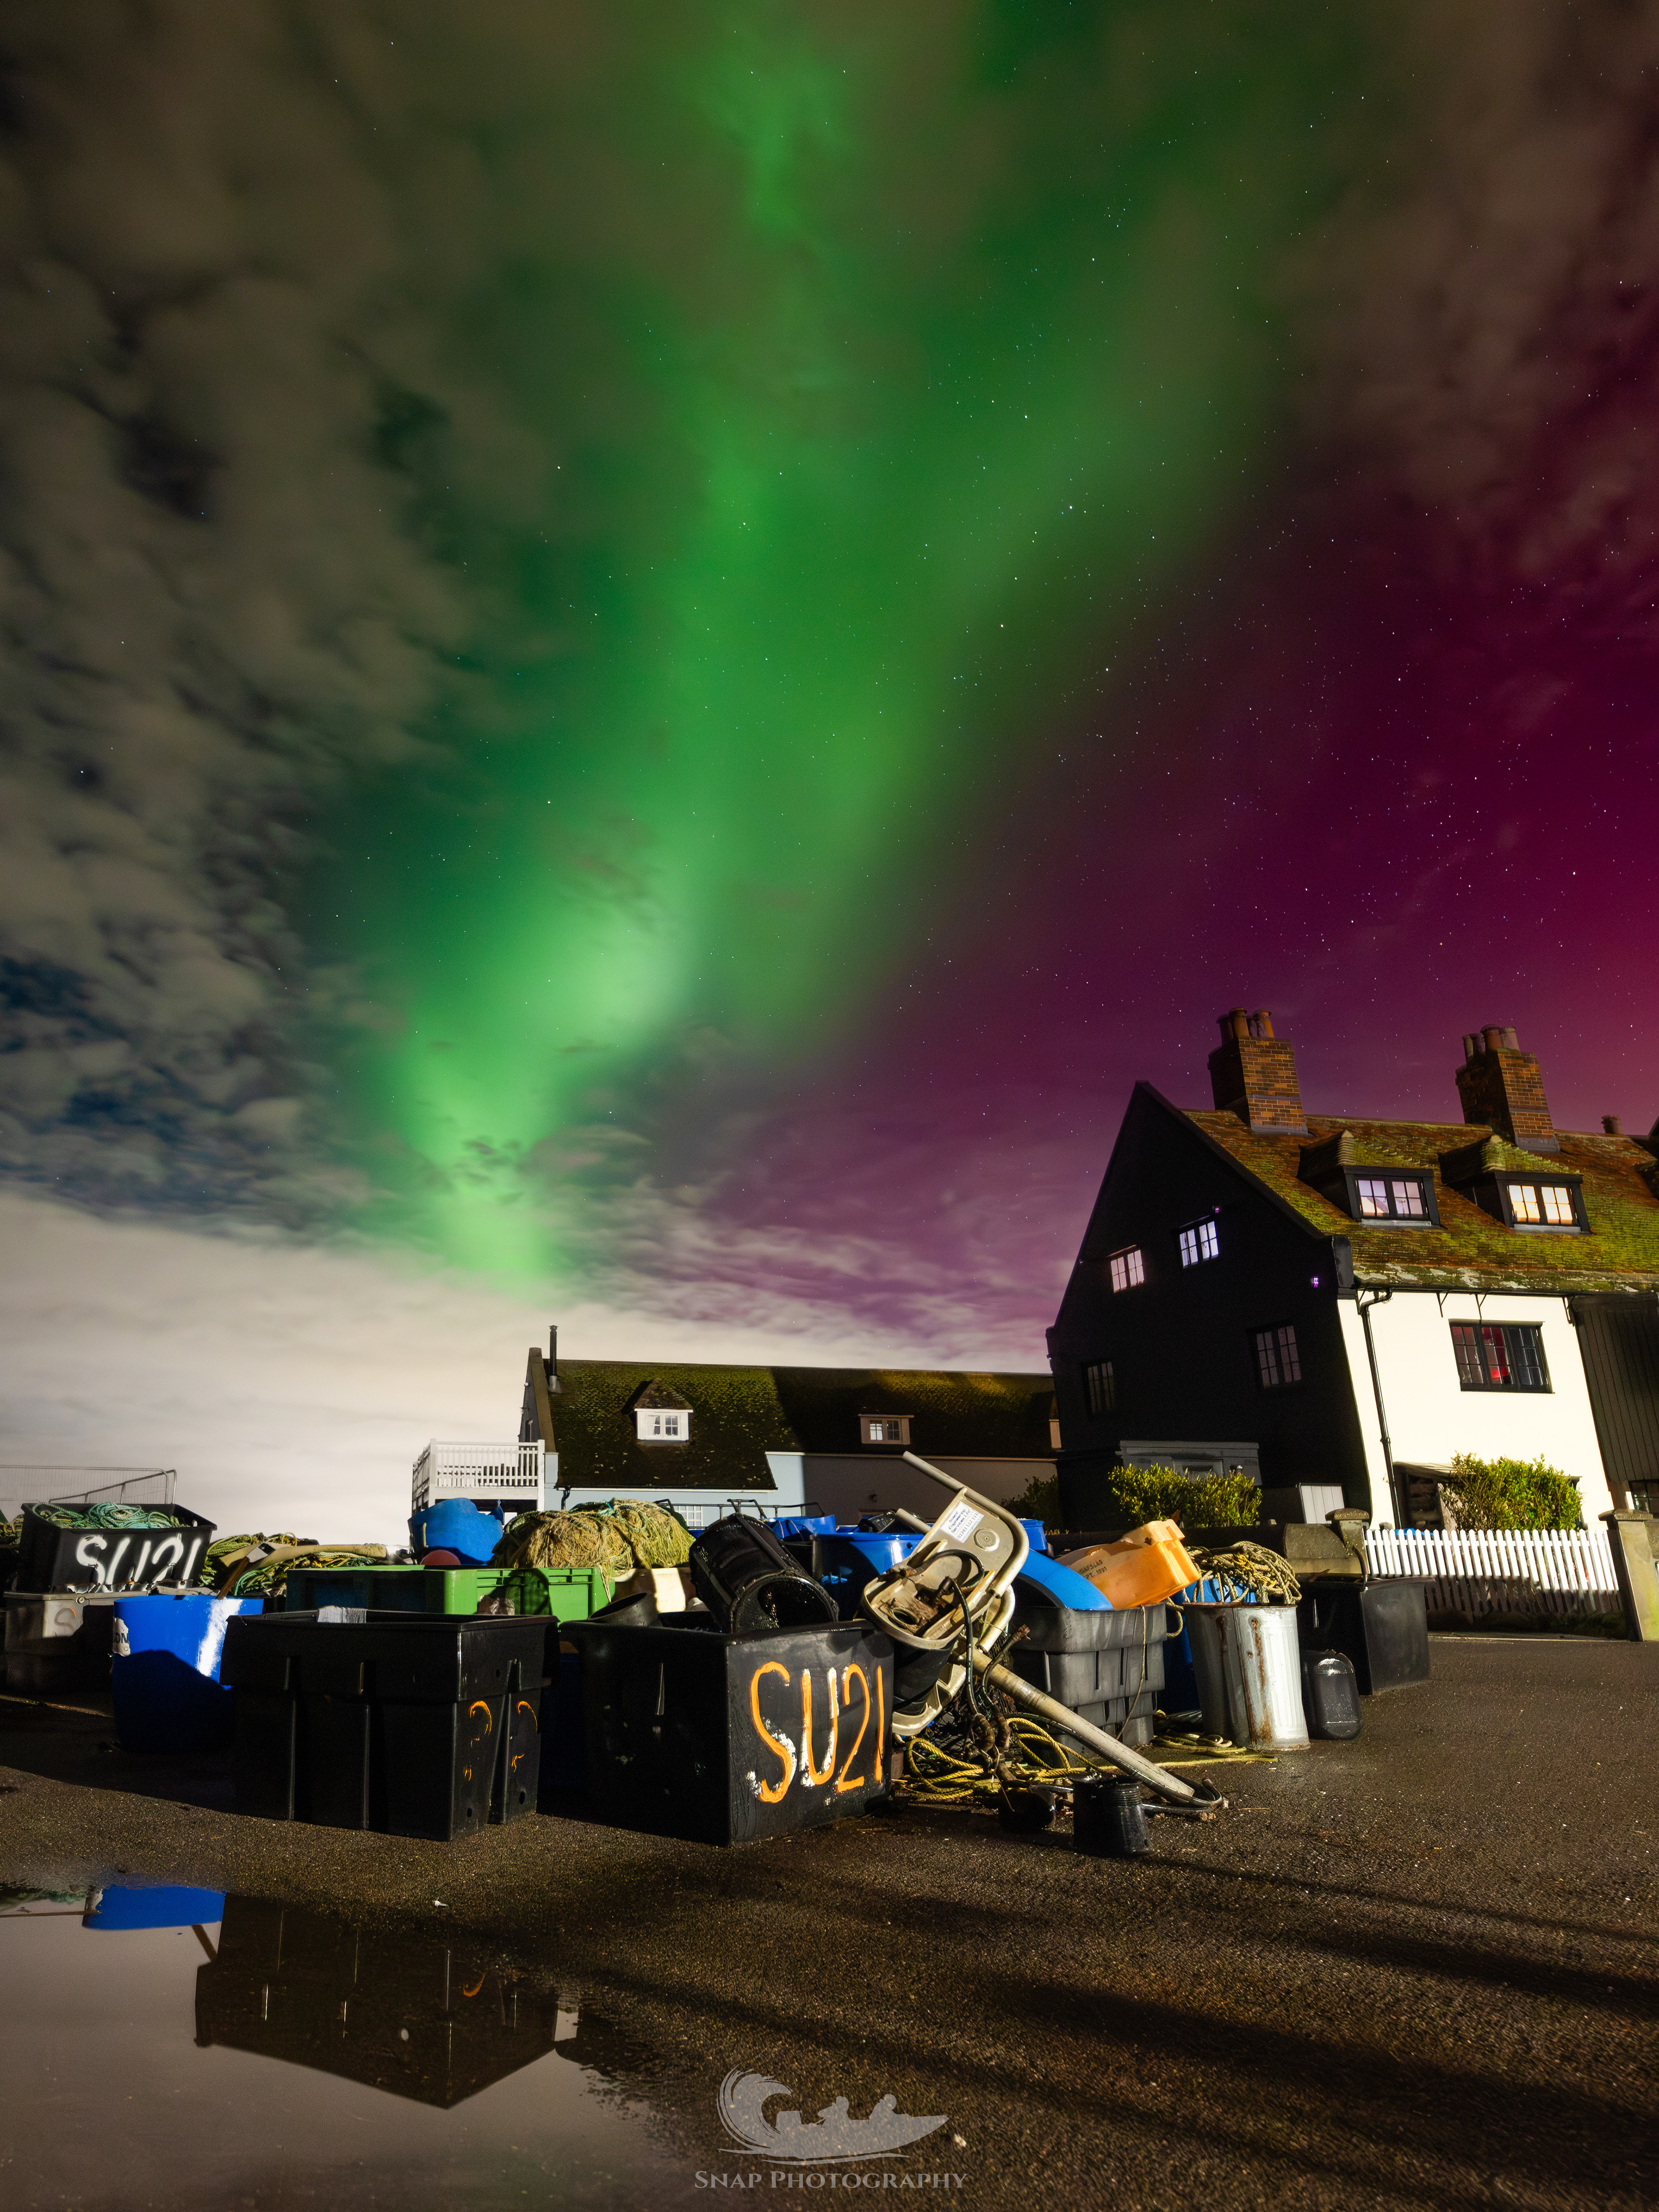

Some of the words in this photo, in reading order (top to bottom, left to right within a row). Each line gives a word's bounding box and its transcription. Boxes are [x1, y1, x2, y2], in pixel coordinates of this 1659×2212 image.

[949, 1509, 966, 1530] Engineering
[951, 1517, 965, 1533] Services
[957, 1527, 968, 1538] 01243
[76, 1533, 202, 1591] SU21
[750, 1661, 885, 1803] SU21
